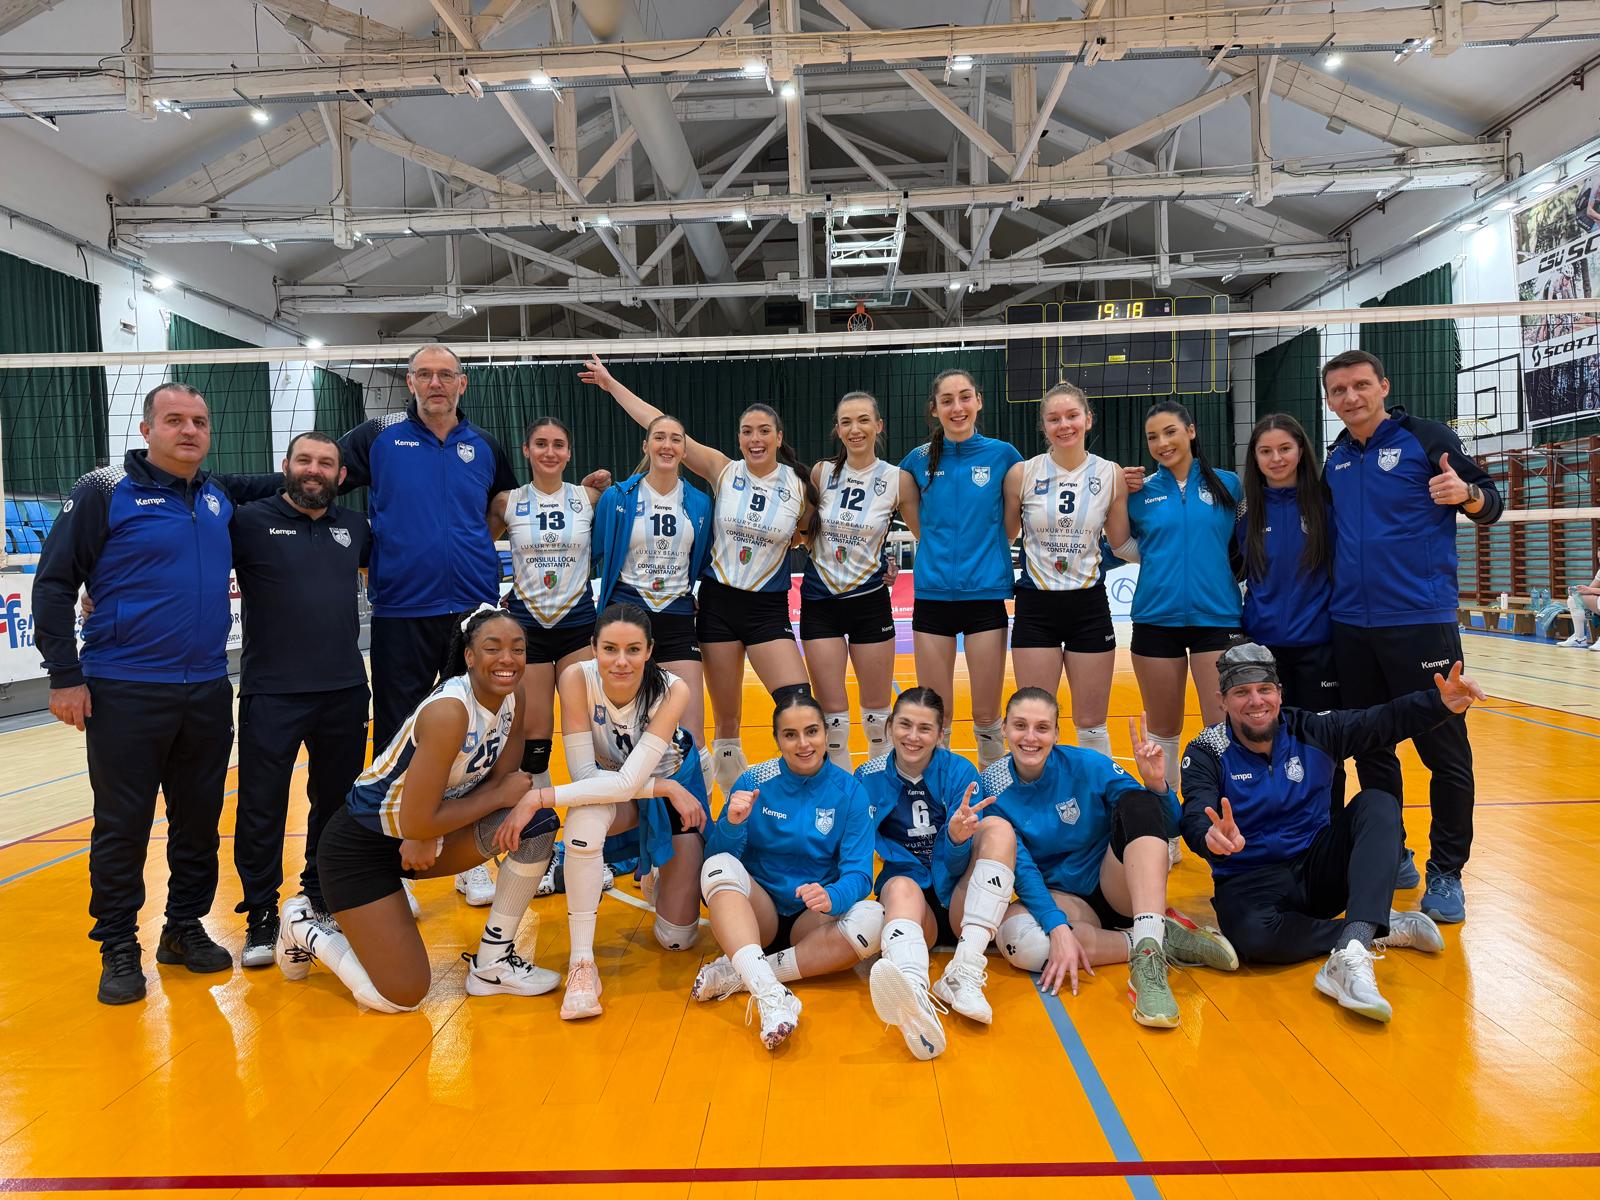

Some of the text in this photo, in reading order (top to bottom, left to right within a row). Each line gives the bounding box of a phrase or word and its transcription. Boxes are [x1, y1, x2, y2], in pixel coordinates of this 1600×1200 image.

[1097, 301, 1143, 320] 19:18
[1543, 334, 1598, 359] SCOTT
[394, 439, 419, 447] Kempa
[135, 497, 166, 506] Kempa
[750, 493, 766, 512] 9
[839, 487, 866, 512] 12
[1058, 490, 1076, 514] 3
[1144, 495, 1168, 505] Kempa
[536, 511, 566, 531] 13
[650, 513, 677, 537] 18
[724, 516, 751, 527] LUXURY
[752, 523, 782, 533] BEAUTY
[820, 519, 844, 527] UXURY
[845, 522, 874, 530] BEAUTY
[269, 527, 297, 536] Kempa
[725, 530, 774, 545] CONSILIUL LOCAL
[849, 535, 867, 543] LOCAL
[1421, 658, 1450, 669] Kempa
[466, 736, 501, 773] 25
[762, 806, 787, 820] Kempa
[912, 799, 931, 829] 6
